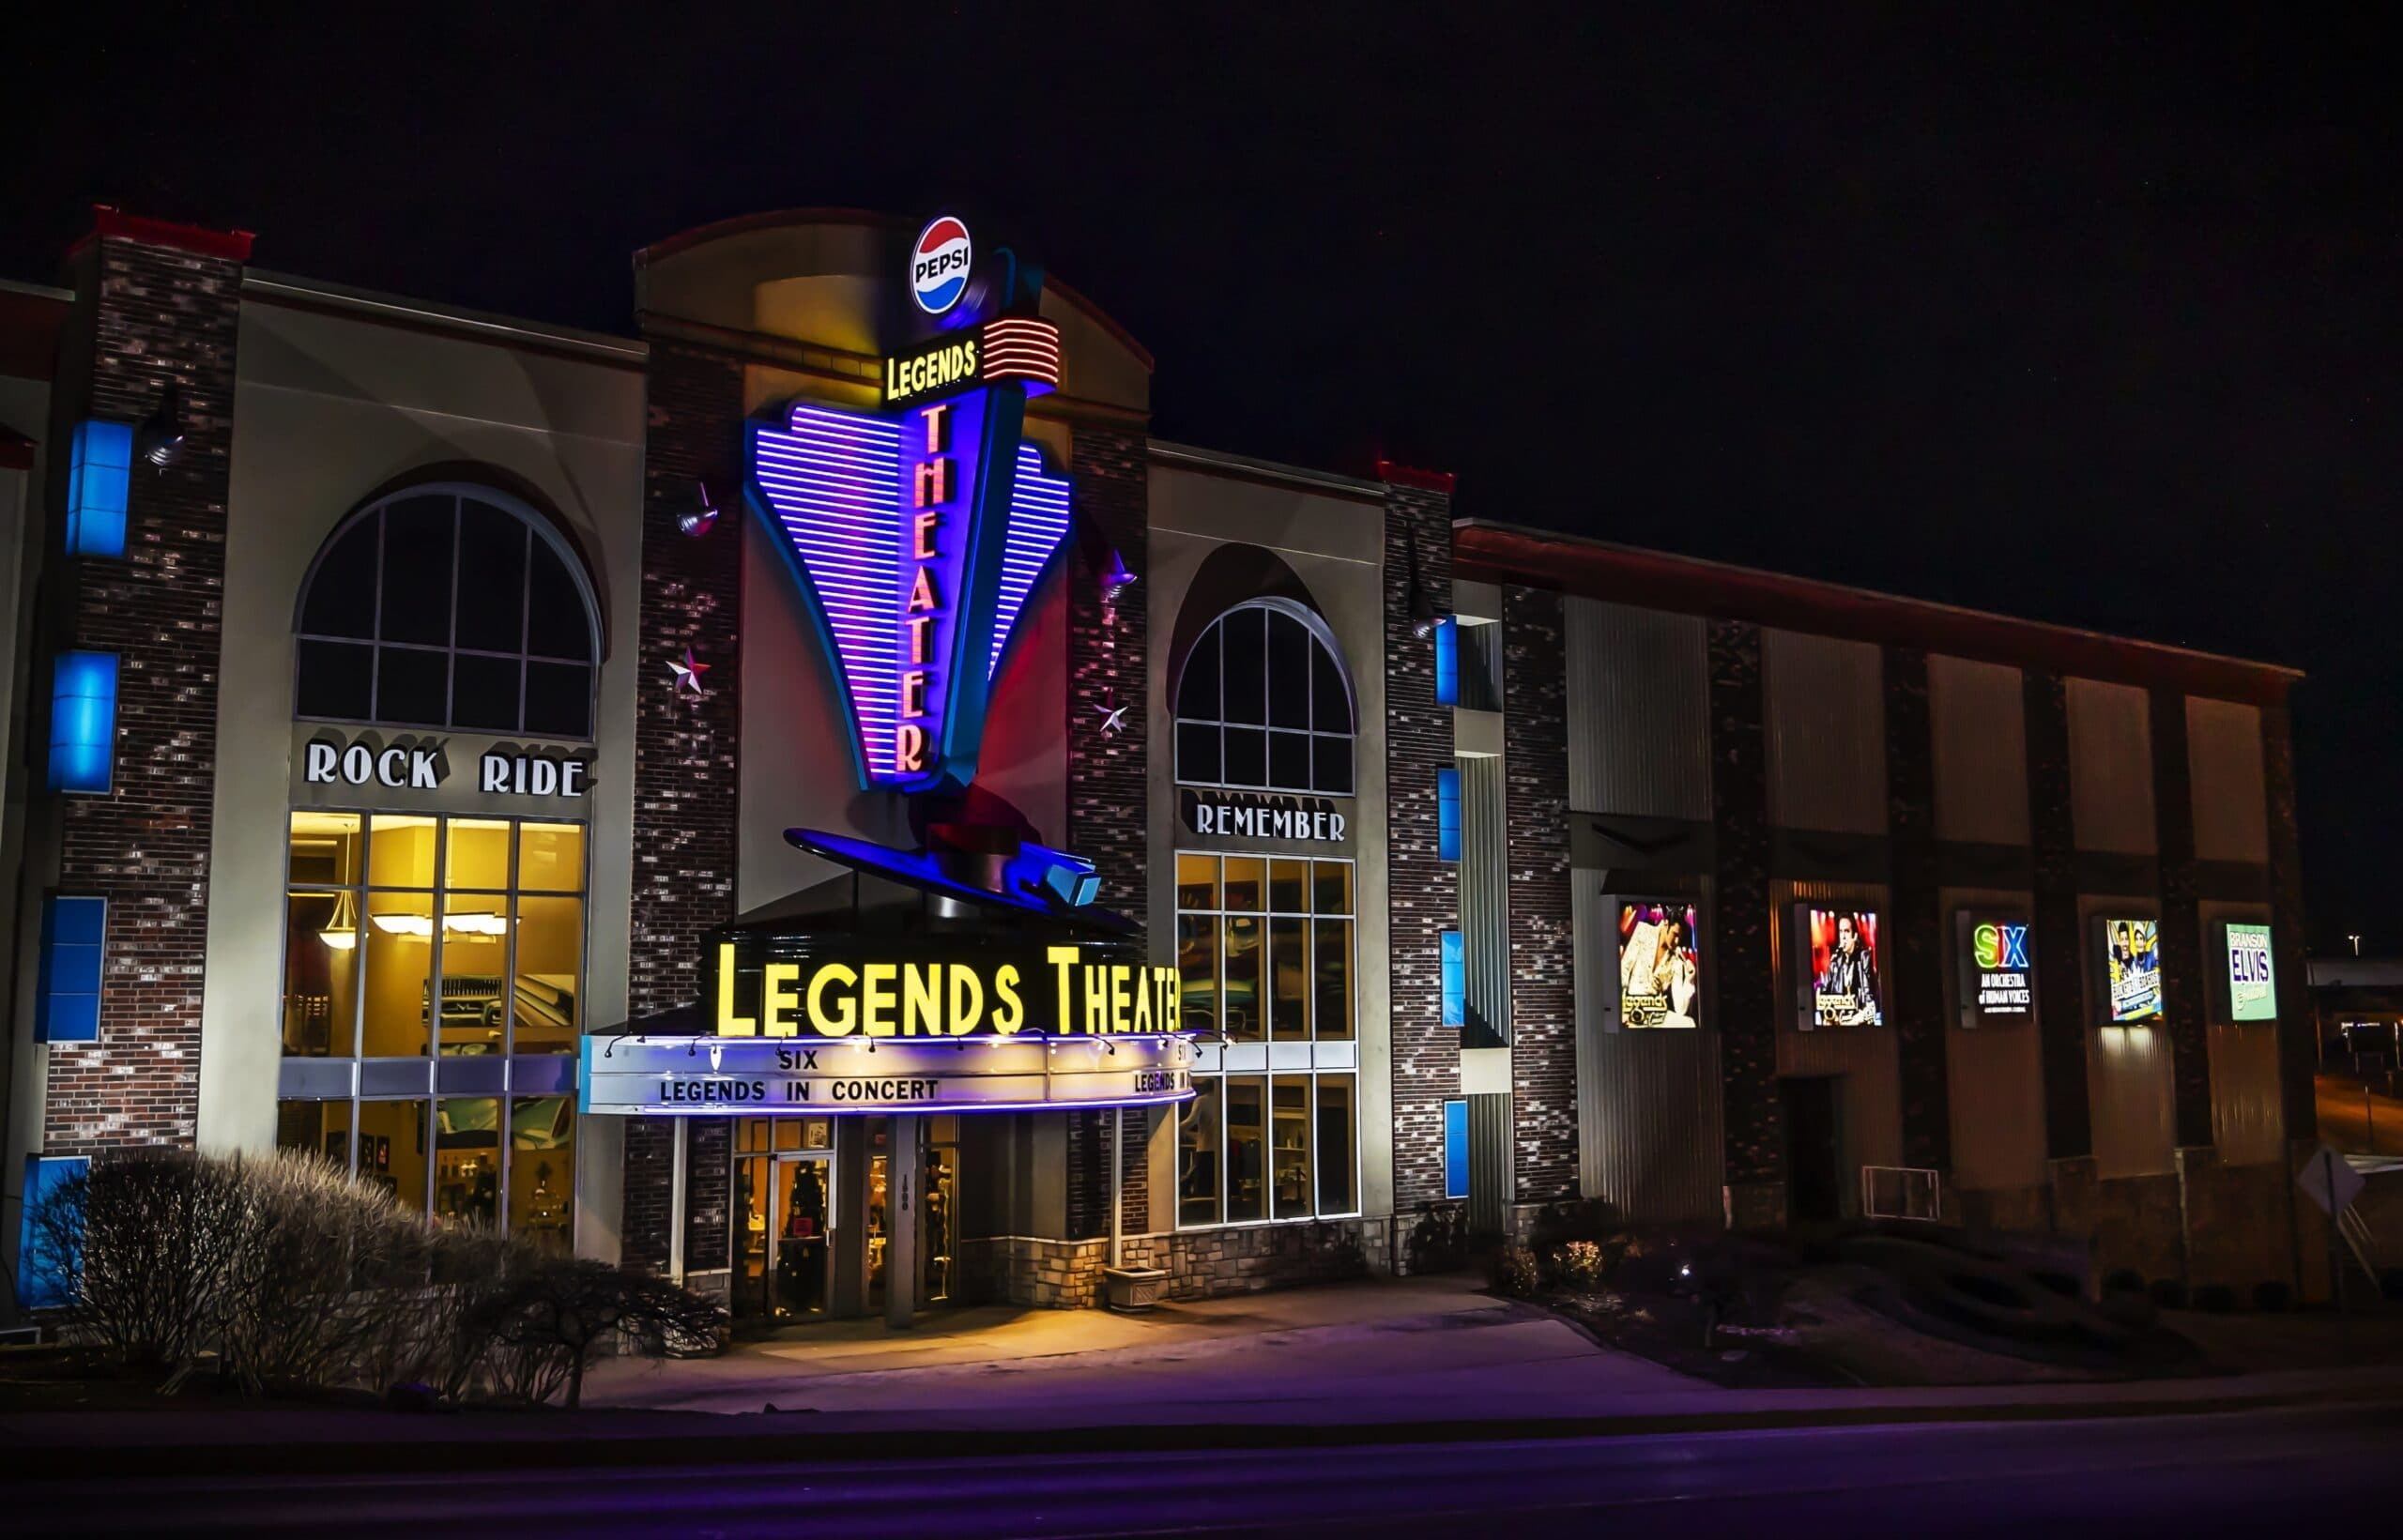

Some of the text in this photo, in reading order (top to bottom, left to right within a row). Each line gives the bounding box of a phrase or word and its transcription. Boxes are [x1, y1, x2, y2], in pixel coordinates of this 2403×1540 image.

[915, 246, 969, 283] PEPSI
[887, 341, 976, 401] LEGENDS
[896, 404, 947, 773] THEATER
[307, 743, 584, 797] ROCK RIDE
[1197, 804, 1345, 842] REMEMBER
[1974, 925, 2028, 968] SIX
[2230, 932, 2268, 948] BRANSON
[2231, 949, 2269, 983] ELVIS
[718, 943, 1181, 1037] LEGENDS THEATER
[2009, 989, 2029, 1003] VOICES
[778, 1050, 818, 1070] SIX
[660, 1080, 938, 1102] LEGENDS IN CONCERT
[1135, 1073, 1174, 1091] LEGENDS
